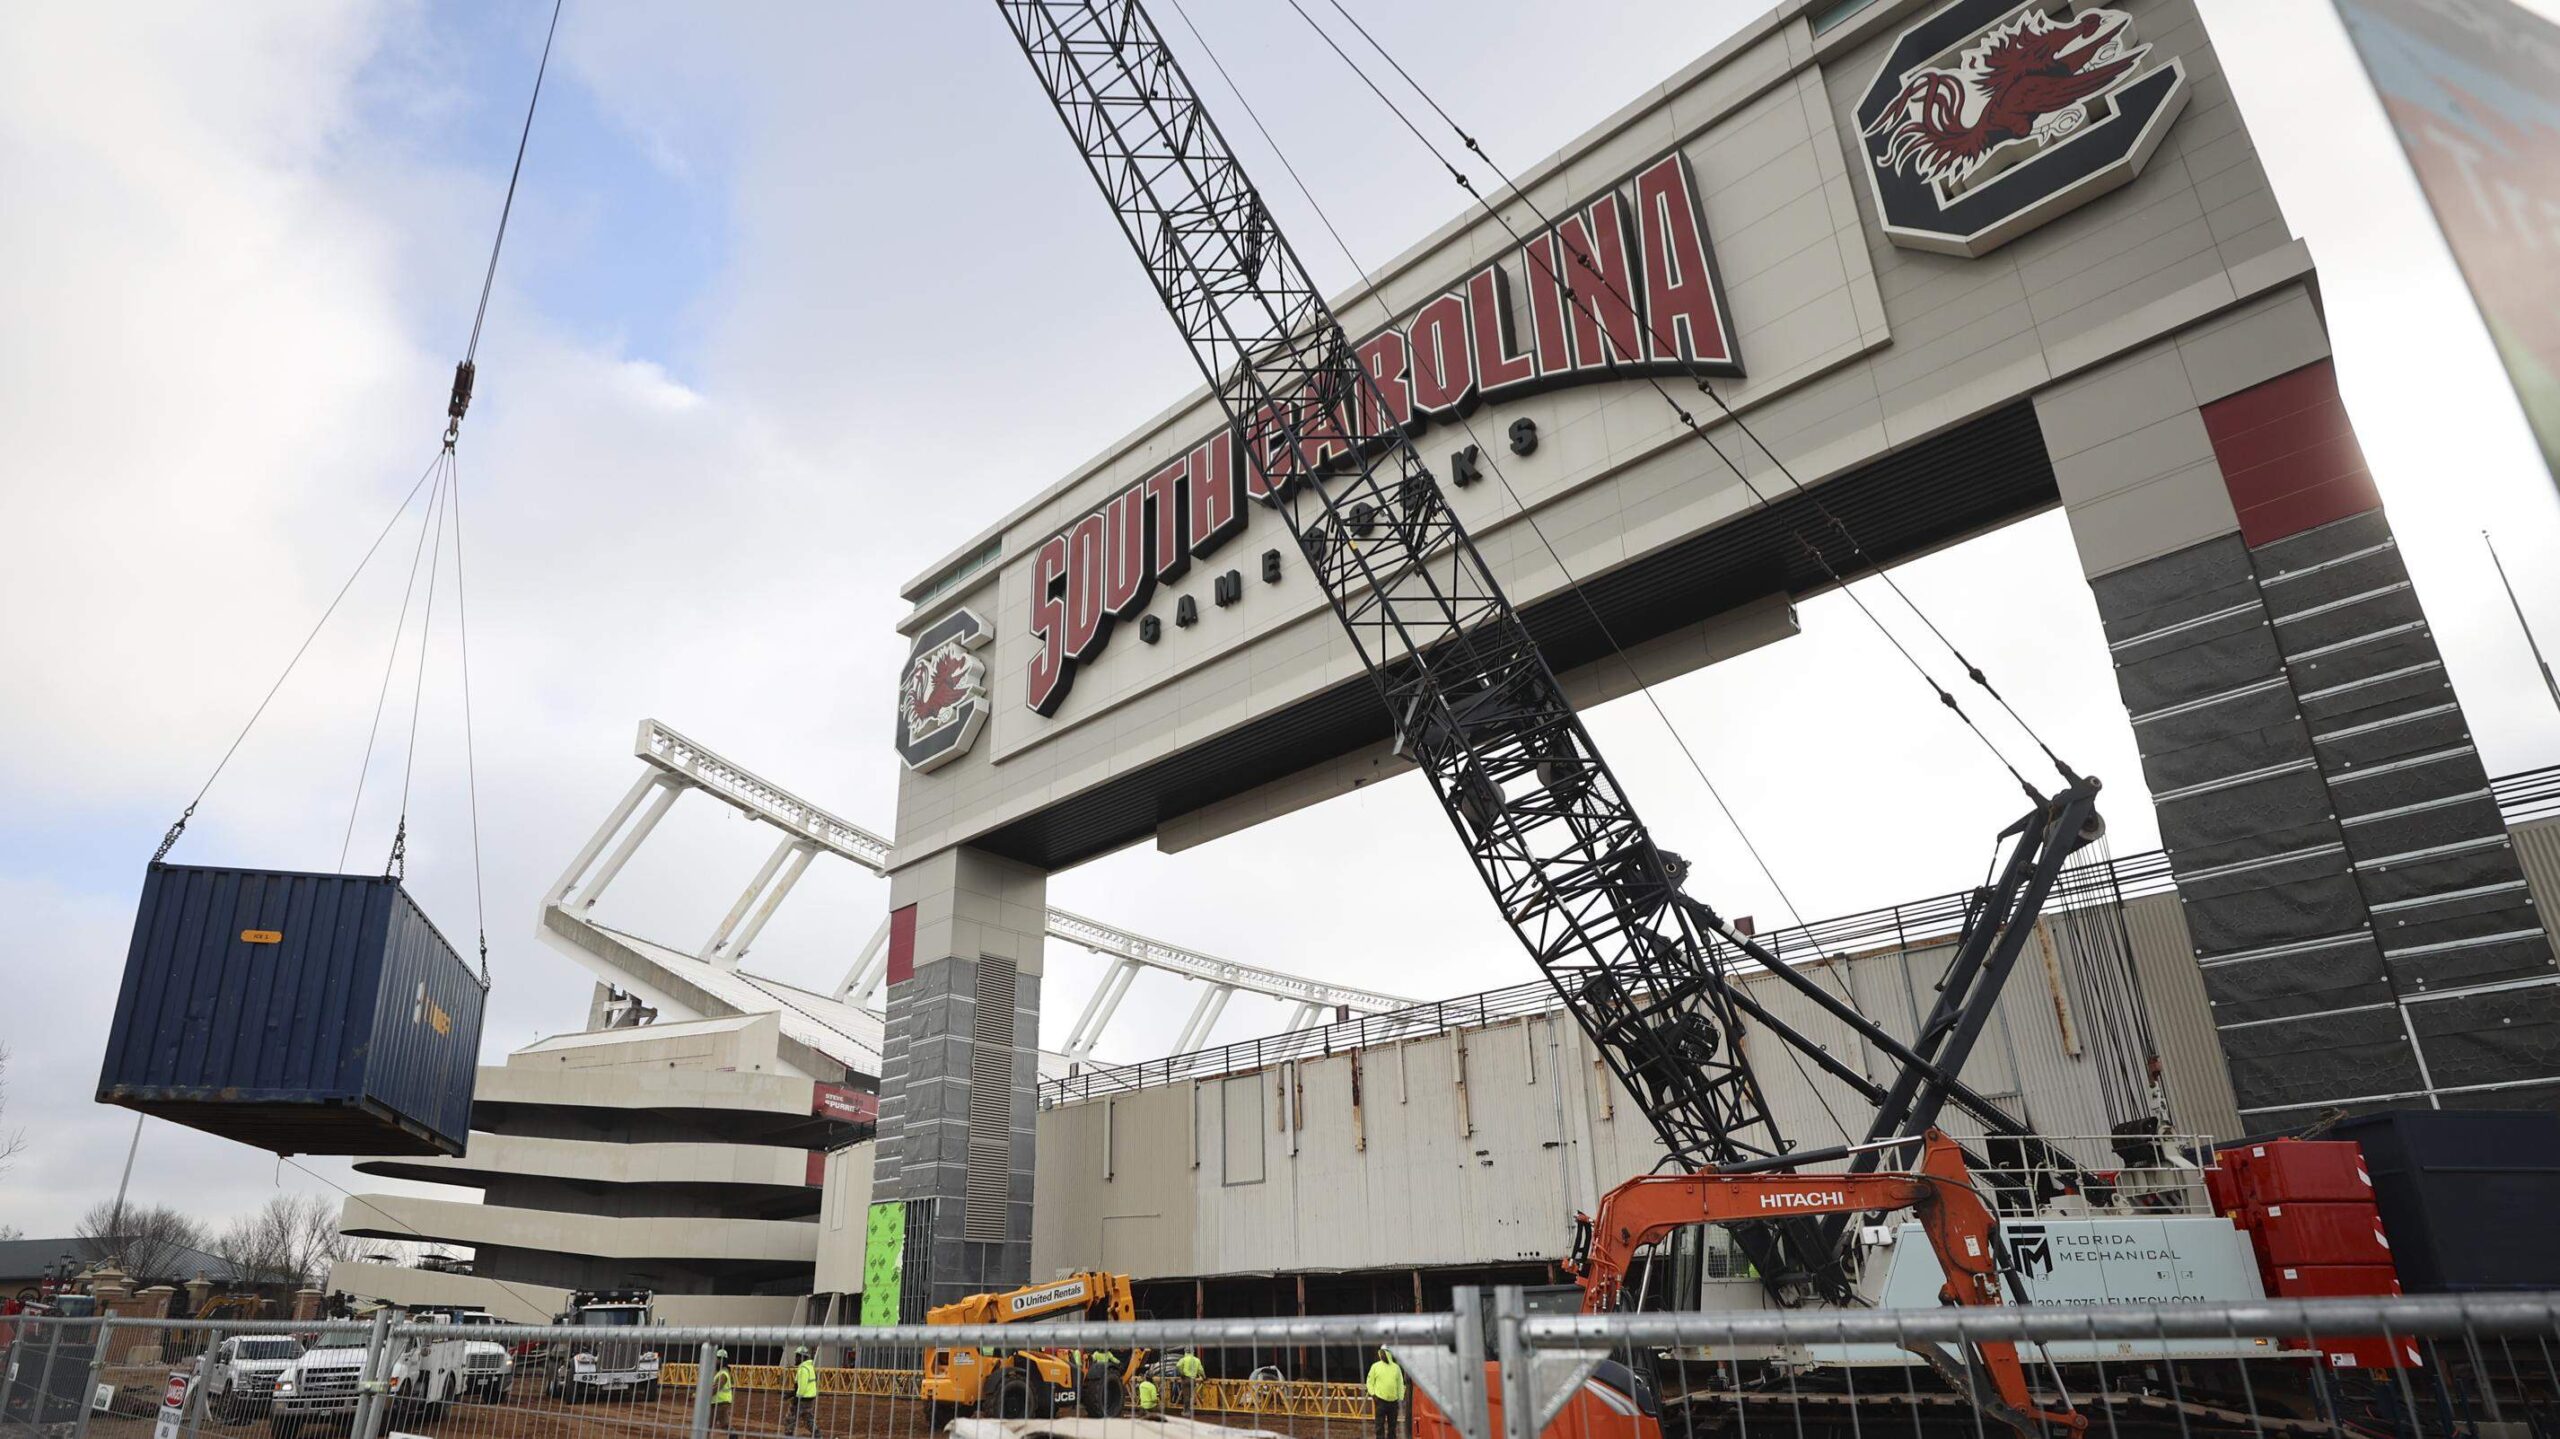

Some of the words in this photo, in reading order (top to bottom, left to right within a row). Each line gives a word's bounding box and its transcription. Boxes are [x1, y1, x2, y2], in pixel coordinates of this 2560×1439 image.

[1026, 427, 1249, 720] SOUTH
[1244, 150, 1746, 506] CAROLINA
[1760, 1191, 1844, 1208] HITACHI
[2056, 1234, 2136, 1246] FLORIDA
[2060, 1250, 2181, 1262] MECHANICAL
[1026, 1290, 1053, 1307] United
[1053, 1284, 1081, 1300] Rentals
[1054, 1391, 1076, 1403] JCB
